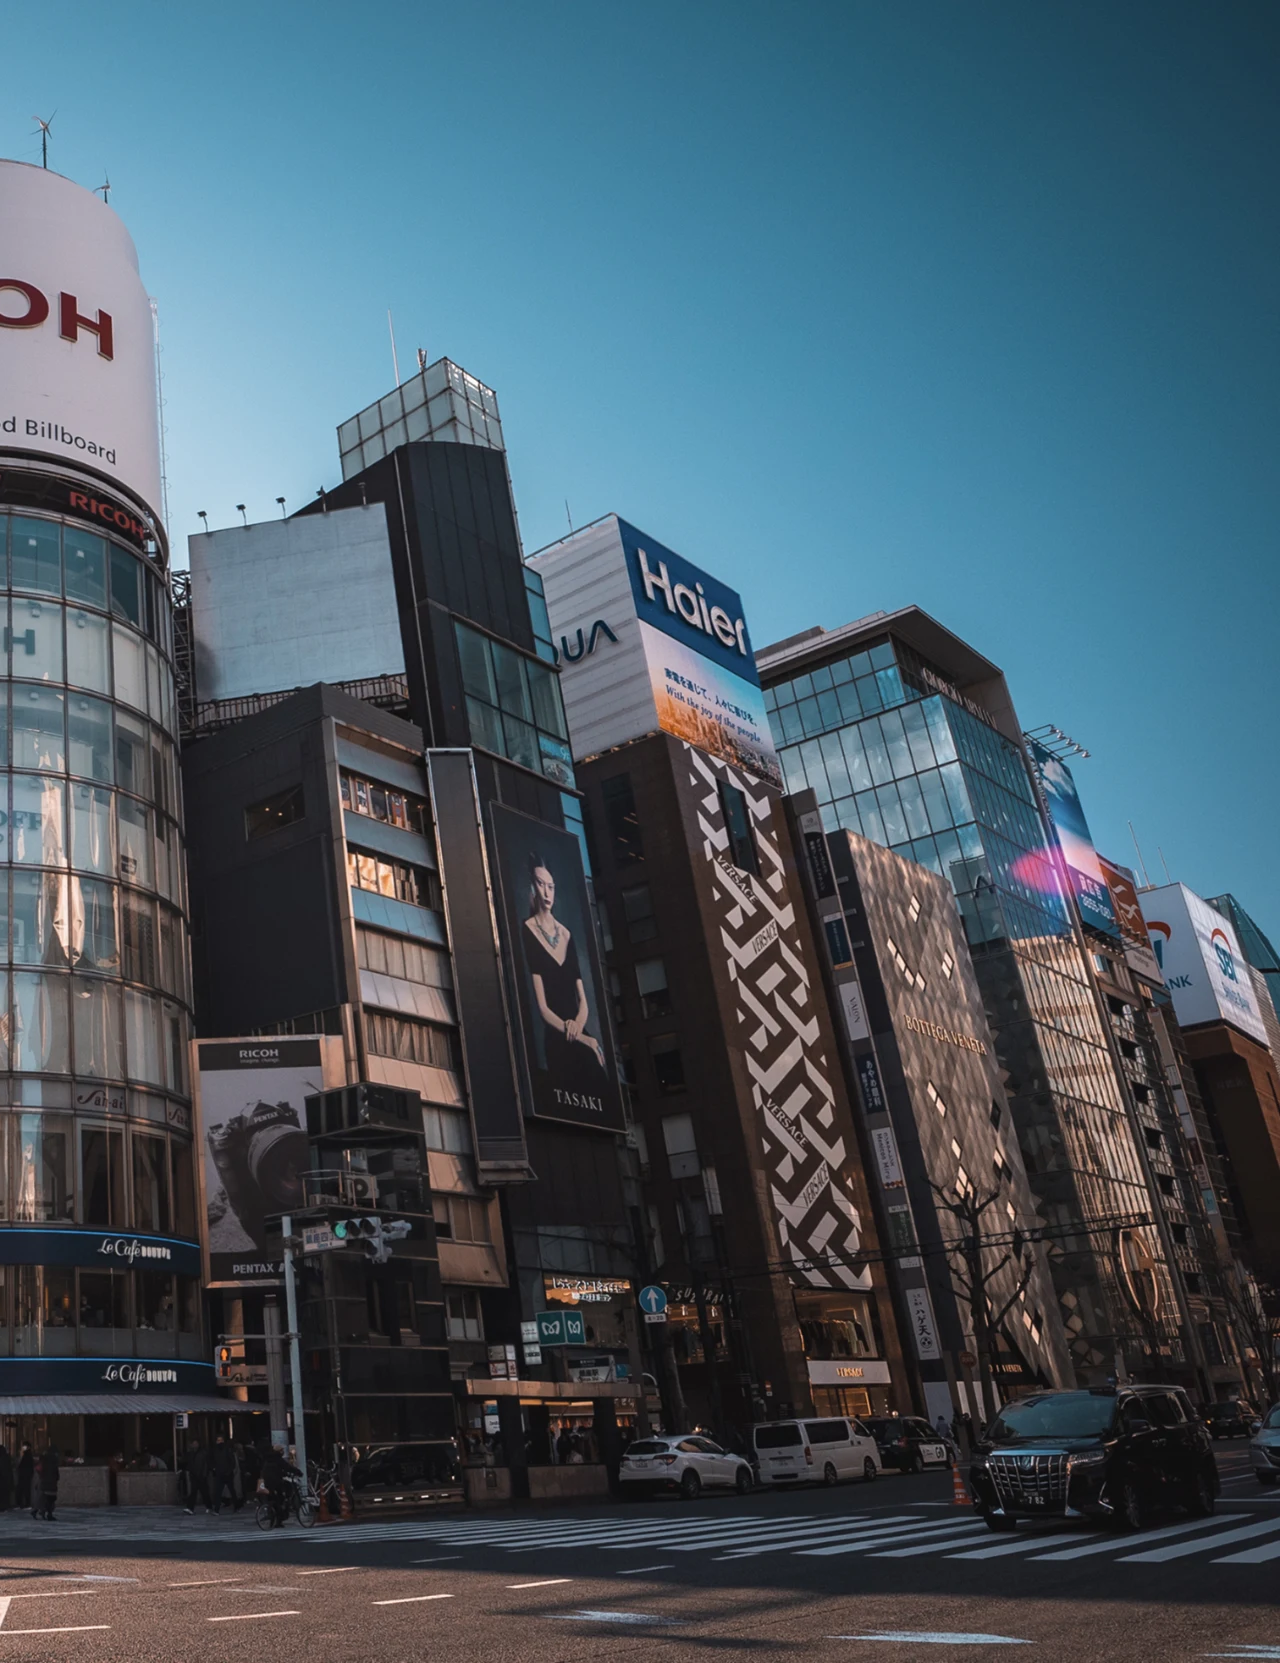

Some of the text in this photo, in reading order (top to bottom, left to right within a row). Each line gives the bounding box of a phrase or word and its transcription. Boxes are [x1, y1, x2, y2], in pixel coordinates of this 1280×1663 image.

[25, 419, 117, 466] Billboard
[69, 490, 145, 541] RICOH
[637, 547, 747, 656] Haier
[553, 619, 618, 667] UA
[666, 684, 686, 703] With
[687, 697, 700, 710] the
[701, 703, 713, 719] joy
[714, 713, 723, 725] of
[724, 717, 736, 730] the
[717, 854, 759, 903] VERSACE
[752, 921, 778, 954] VERSACE
[1162, 974, 1193, 991] ANK
[239, 1049, 279, 1058] RICOH
[904, 1014, 987, 1056] BOTTEGA VENETA
[253, 1111, 279, 1123] PENTAX
[553, 1088, 603, 1112] TASAKI
[766, 1098, 809, 1148] VERSACE
[803, 1163, 829, 1207] VERSACE
[97, 1238, 171, 1263] Le Café DOUTOR
[233, 1263, 274, 1274] PENTAX
[101, 1364, 177, 1390] Le Café DOUTOR
[835, 1367, 864, 1377] VERSACE
